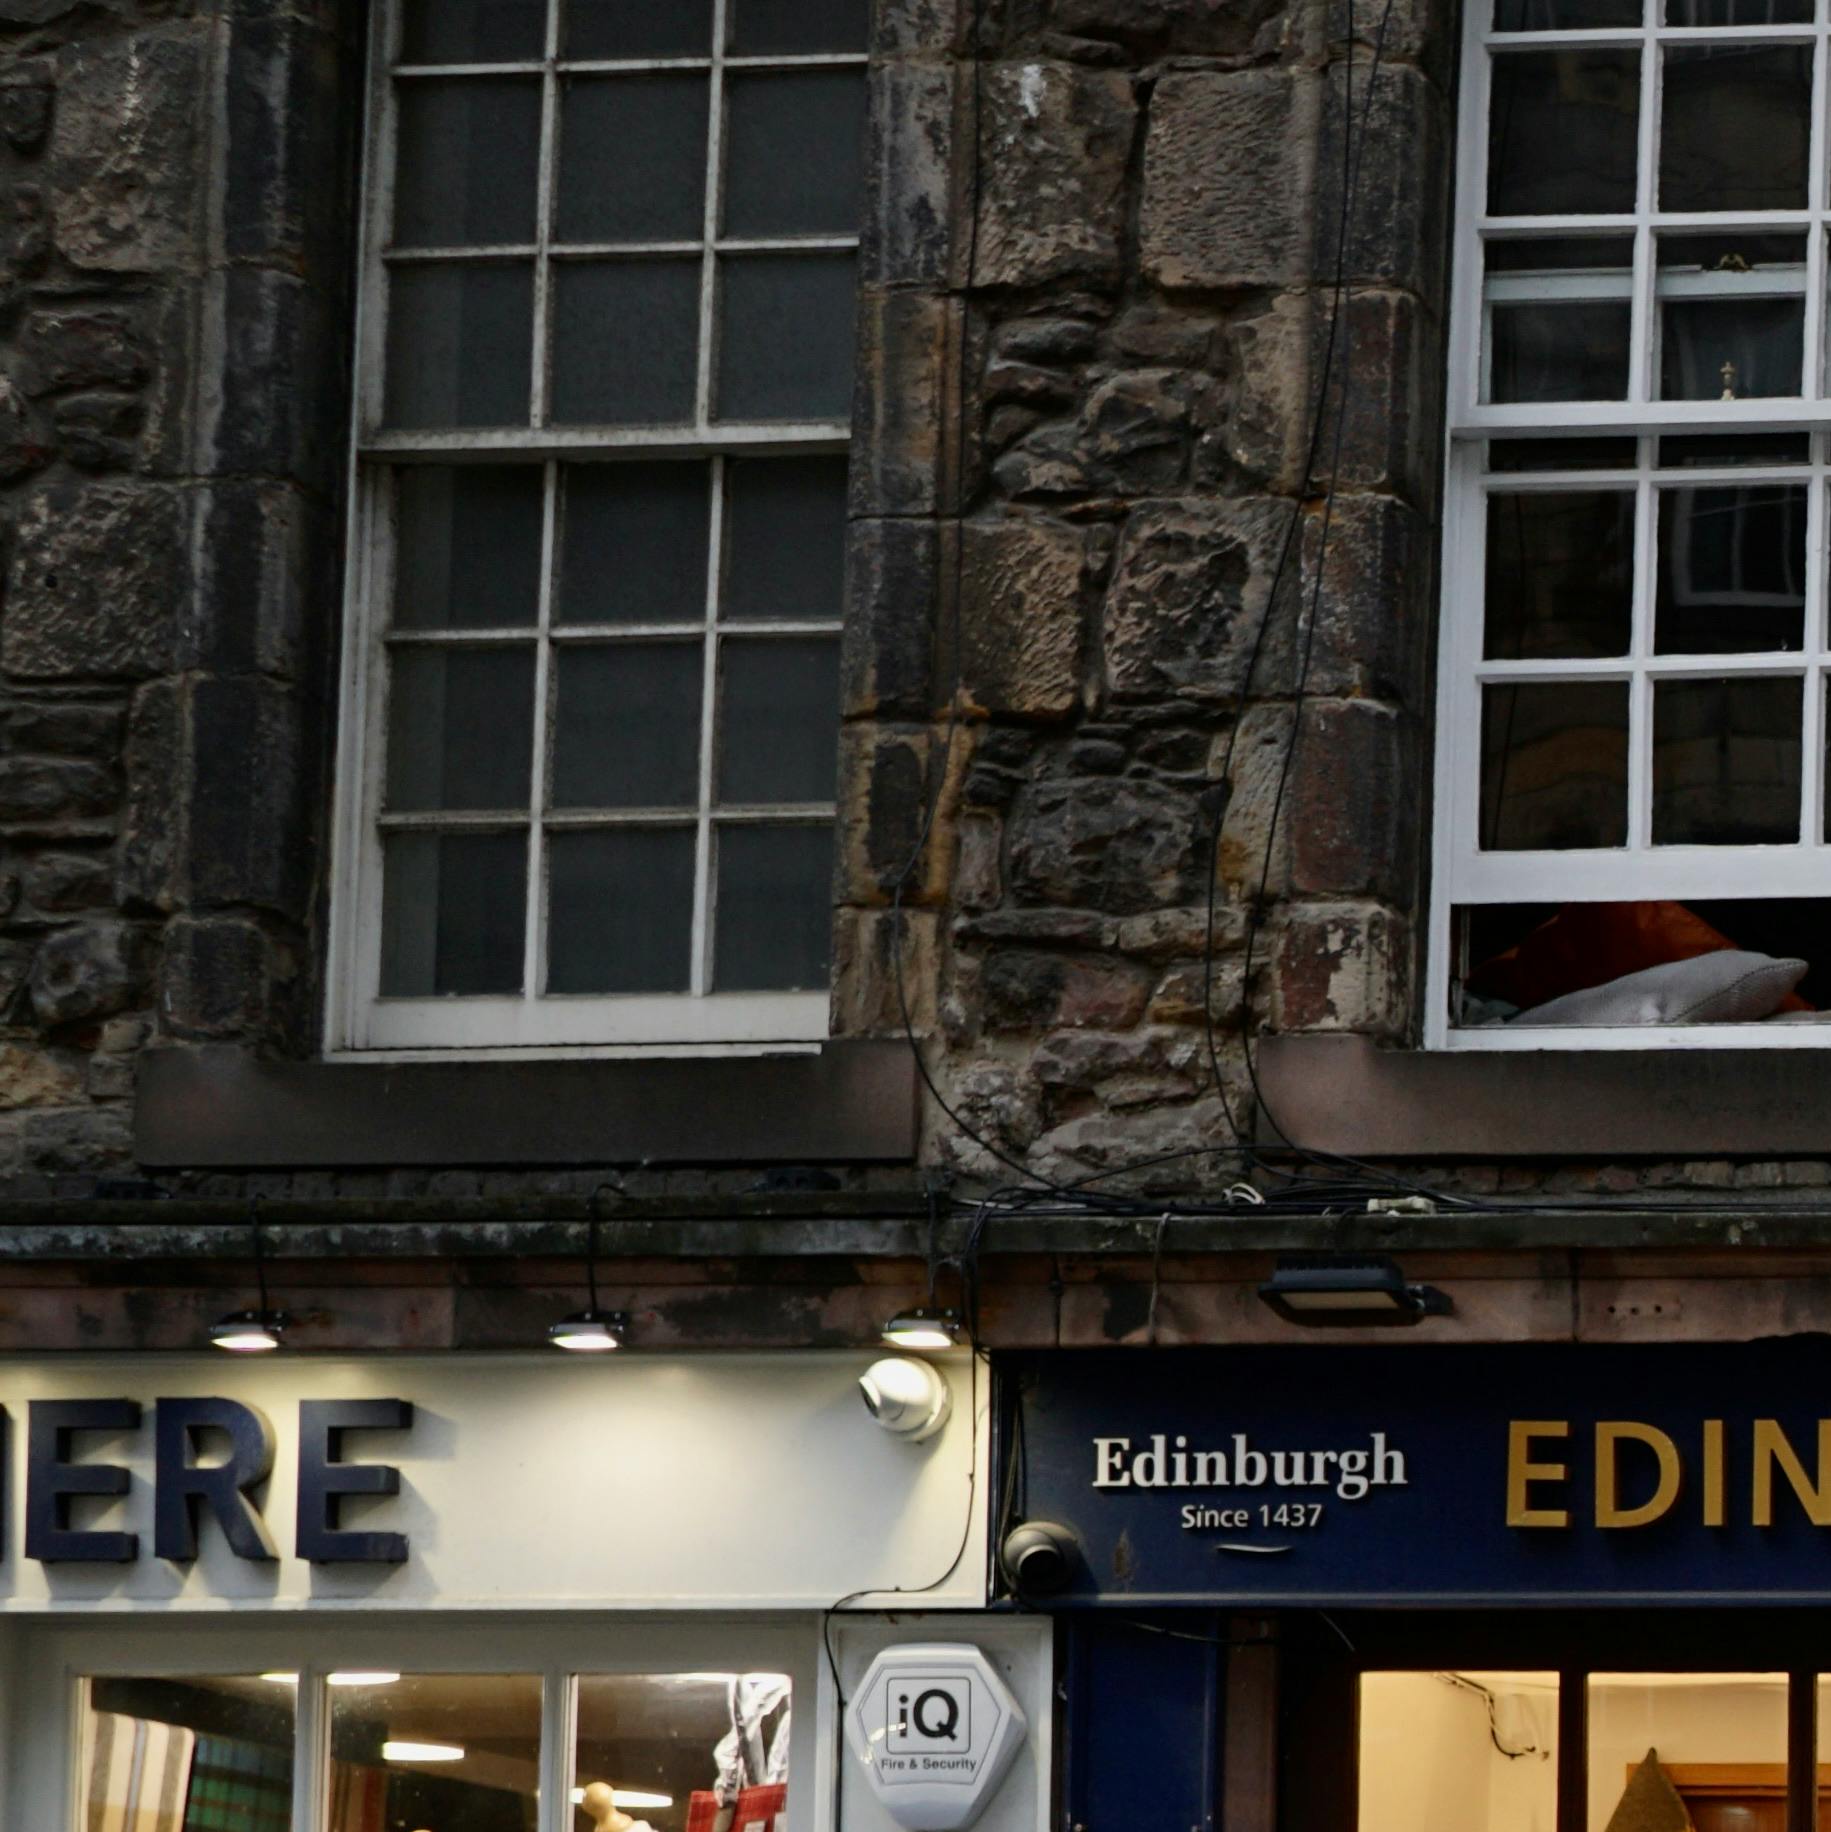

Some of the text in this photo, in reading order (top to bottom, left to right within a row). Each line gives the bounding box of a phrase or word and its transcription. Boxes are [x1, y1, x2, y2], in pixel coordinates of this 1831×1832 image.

[0, 1398, 414, 1563] ERE
[1092, 1432, 1408, 1500] Edinburgh
[1181, 1504, 1322, 1529] Since 1437
[899, 1688, 959, 1741] iQ
[881, 1758, 977, 1773] Fire & Security
